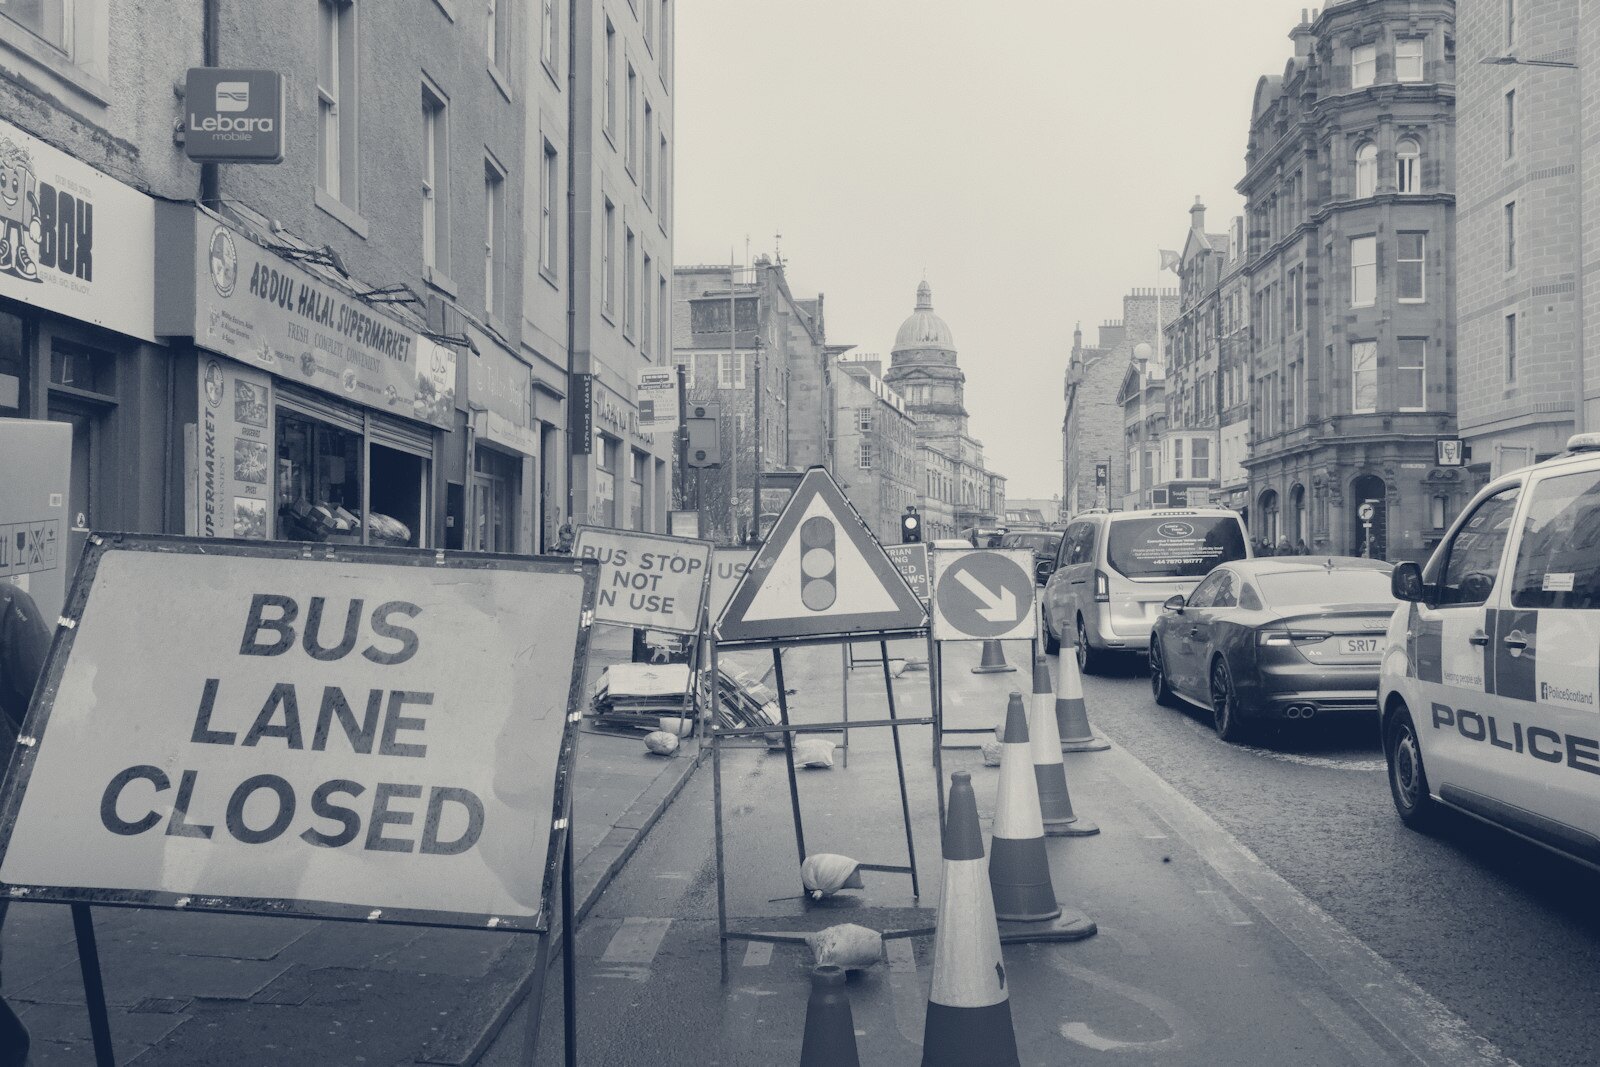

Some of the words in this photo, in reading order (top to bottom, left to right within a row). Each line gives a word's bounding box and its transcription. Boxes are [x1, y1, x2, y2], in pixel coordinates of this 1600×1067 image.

[191, 113, 273, 132] Lebara
[212, 132, 252, 141] mobile
[39, 181, 93, 283] BOX
[250, 262, 294, 311] ABDUL
[297, 284, 334, 329] HALAL
[337, 304, 411, 362] SUPERMARKET
[288, 321, 309, 344] FRESH
[315, 332, 343, 358] COMPLETE
[582, 546, 628, 567] BUS
[638, 552, 702, 575] STOP
[897, 565, 916, 574] ED
[612, 570, 663, 592] NOT
[629, 594, 675, 614] USE
[239, 593, 423, 665] BUS
[1348, 640, 1376, 651] SR17
[1460, 674, 1473, 686] people
[1548, 685, 1593, 705] PoliceScotland
[190, 678, 434, 758] LANE
[1431, 702, 1600, 776] POLICE
[99, 764, 485, 855] CLOSED
